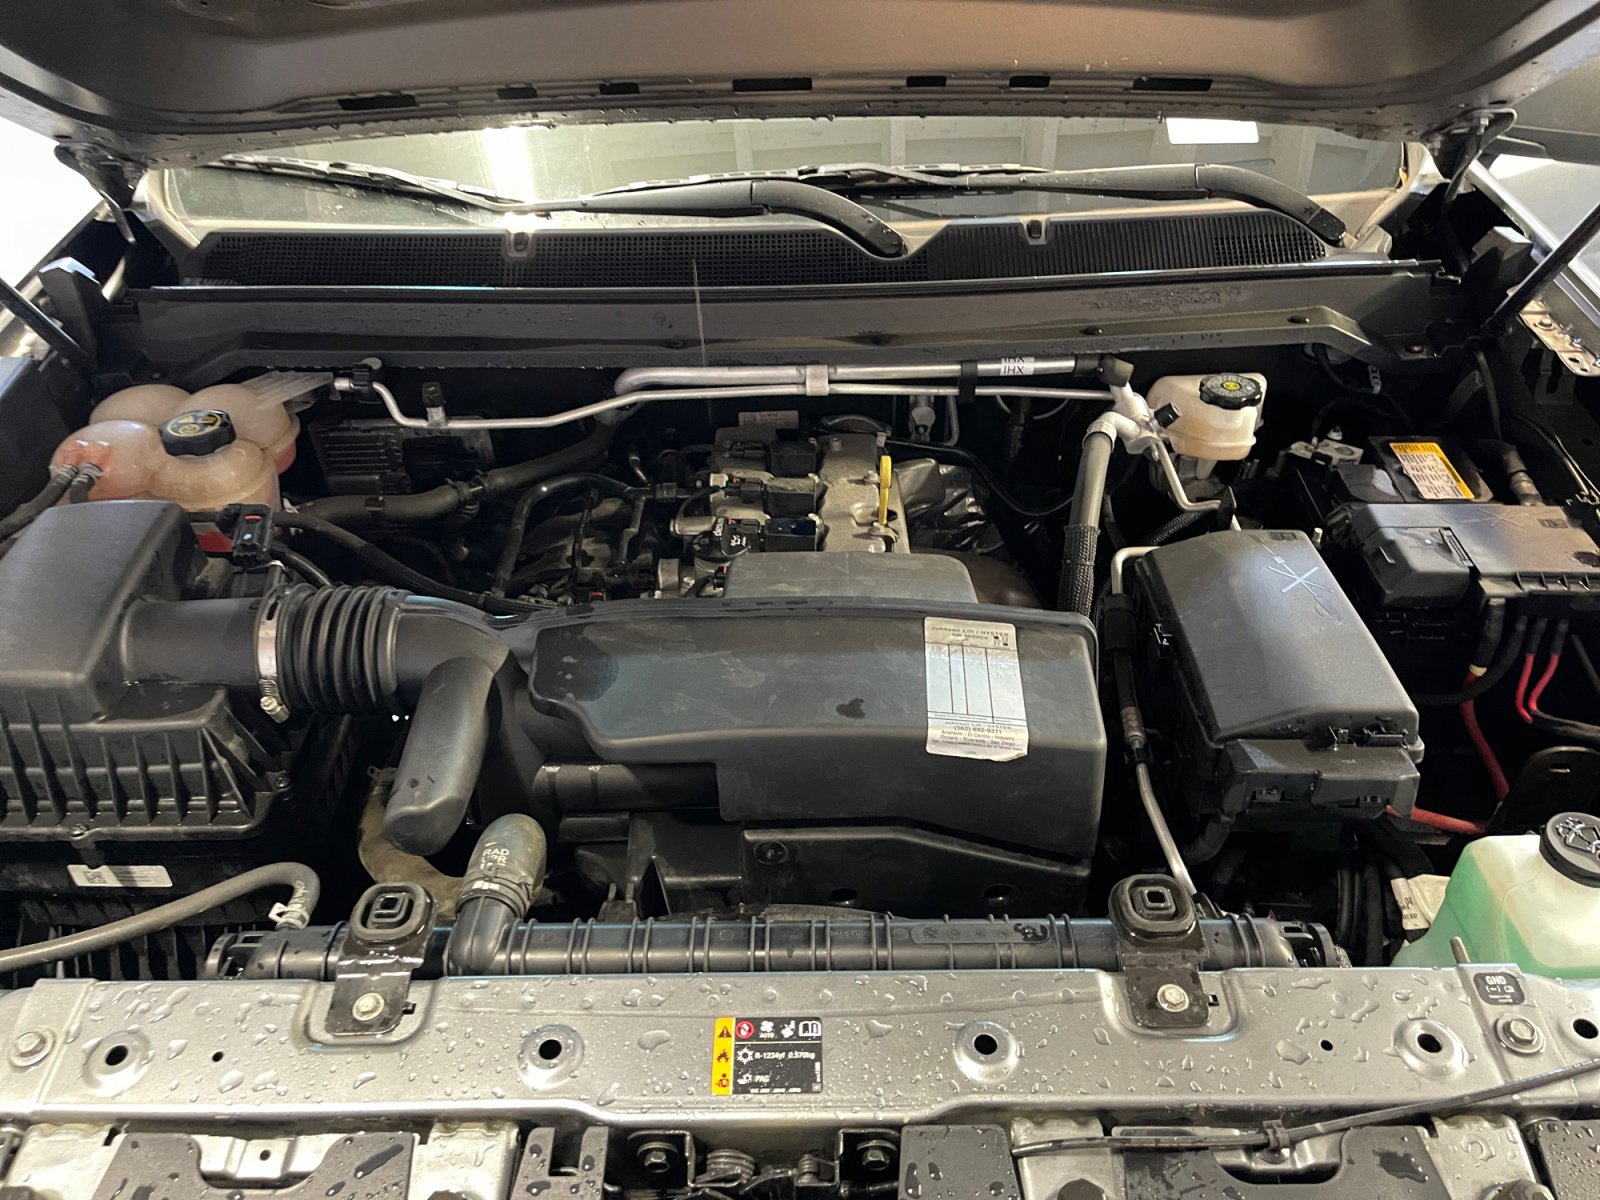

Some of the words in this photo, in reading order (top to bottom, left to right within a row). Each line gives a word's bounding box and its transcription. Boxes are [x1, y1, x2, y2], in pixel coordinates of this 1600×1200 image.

[482, 848, 510, 857] RAD
[1485, 975, 1507, 985] GND
[754, 1052, 786, 1060] R-1234yf
[754, 1074, 770, 1083] PAG
